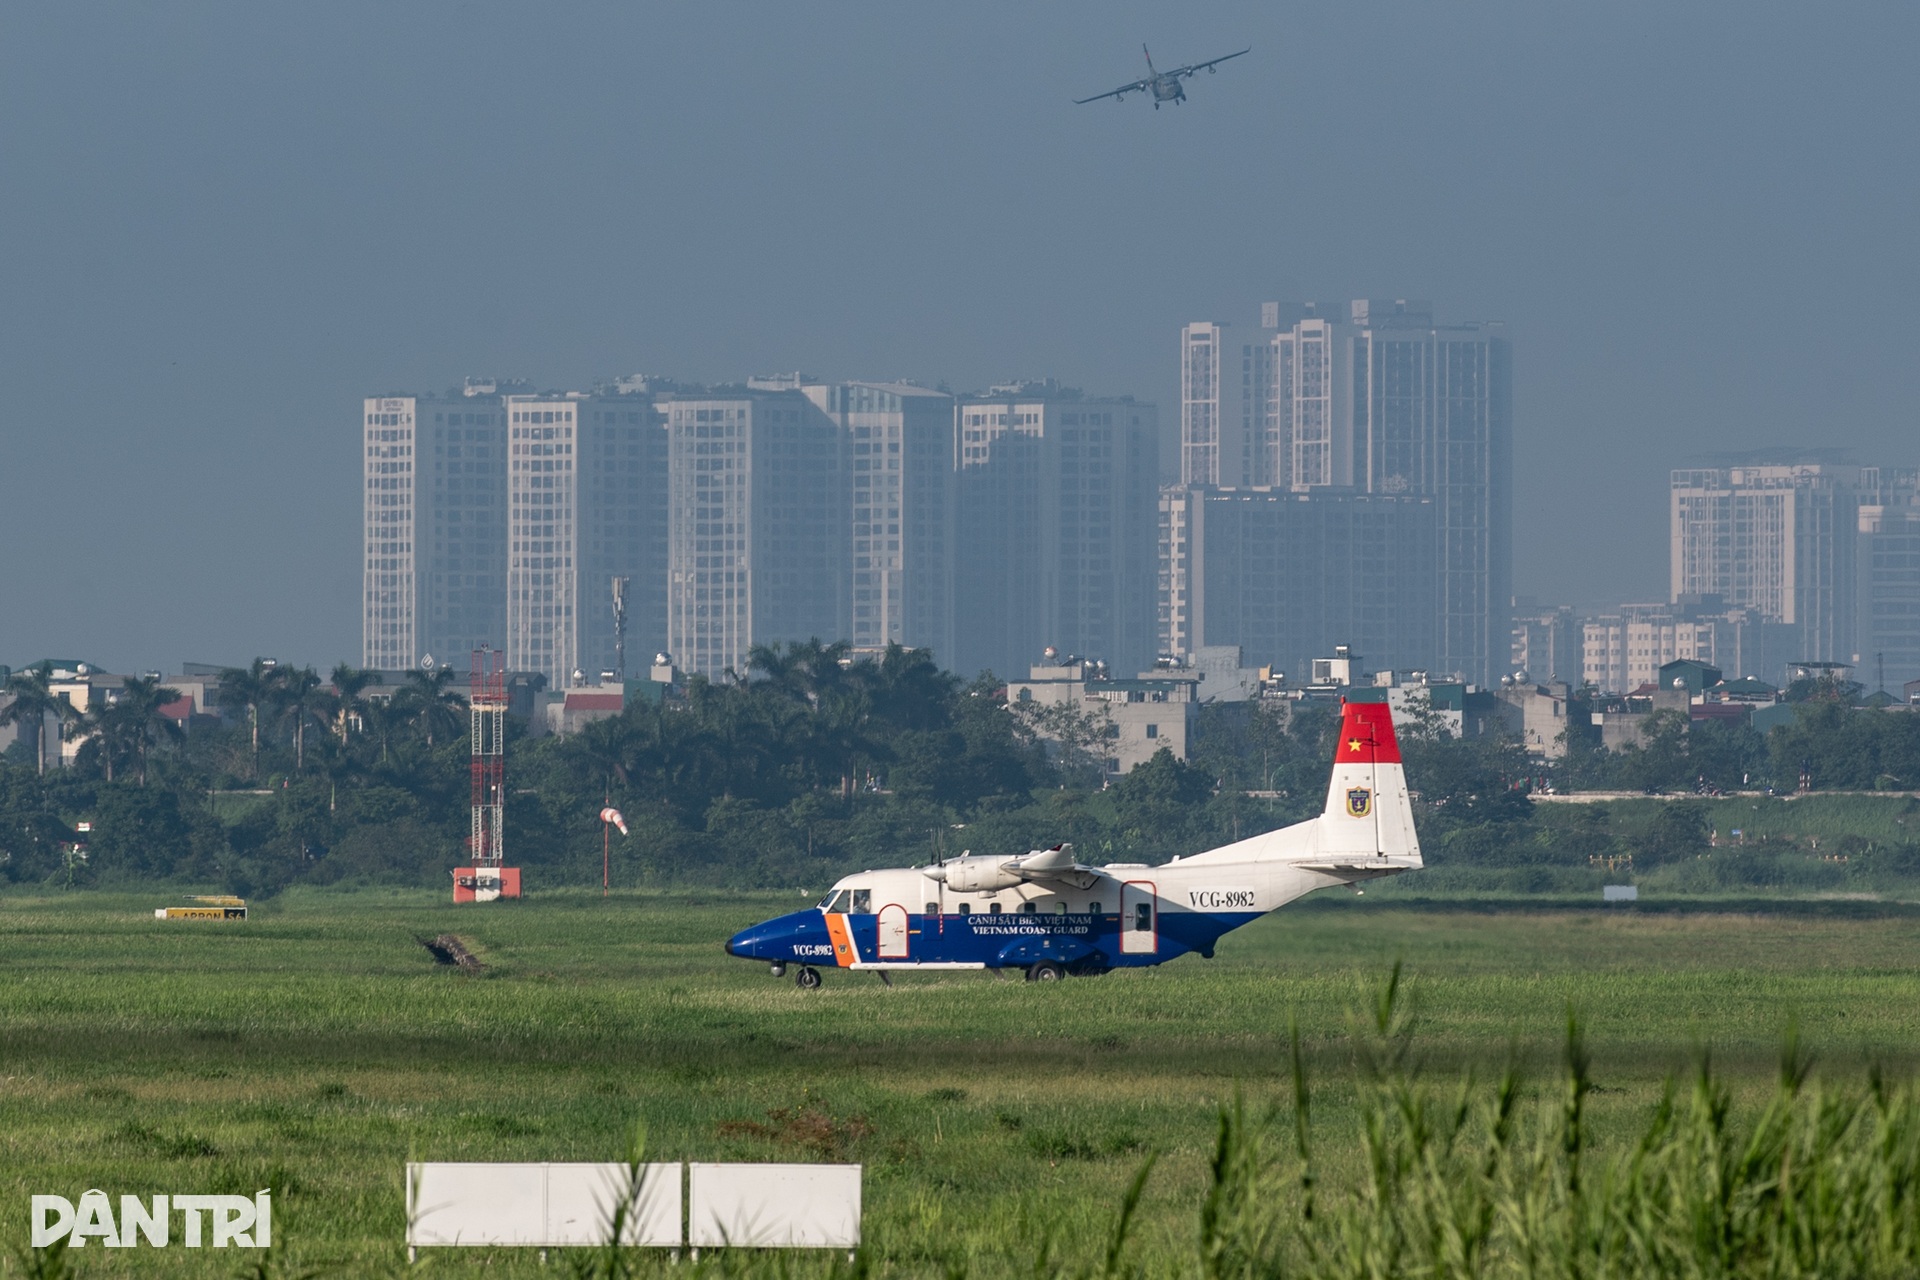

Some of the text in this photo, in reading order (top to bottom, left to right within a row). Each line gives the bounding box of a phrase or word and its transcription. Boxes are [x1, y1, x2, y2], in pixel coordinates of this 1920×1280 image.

[1189, 891, 1255, 908] VCG-8982
[1068, 916, 1092, 925] NAM
[973, 926, 1088, 934] VIETNAM COAST GUARD
[793, 944, 833, 956] VCG-8982
